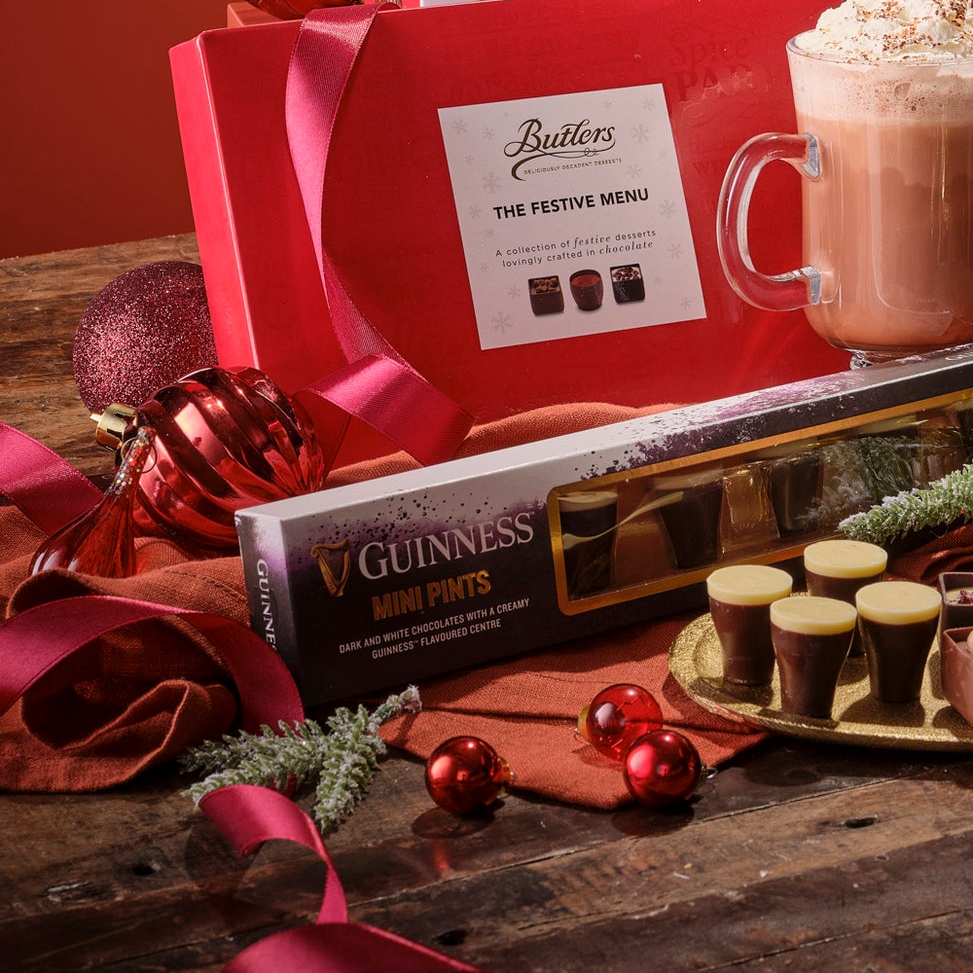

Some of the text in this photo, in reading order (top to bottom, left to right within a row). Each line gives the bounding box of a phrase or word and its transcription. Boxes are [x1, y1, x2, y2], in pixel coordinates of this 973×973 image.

[503, 117, 616, 161] Butlers
[493, 188, 649, 220] THE FESTIVE MENU
[495, 229, 656, 257] A collection of festive desserts
[502, 256, 542, 268] lovingly
[547, 251, 583, 262] crafted
[599, 241, 653, 255] chocolate
[256, 558, 277, 651] GUINNE
[372, 569, 492, 621] MINI PINTS
[339, 597, 530, 654] DARK AND WHITE CHOCOLATES WITH A CREAMY
[420, 629, 468, 646] FLAVOURED
[469, 618, 501, 635] CENTRE
